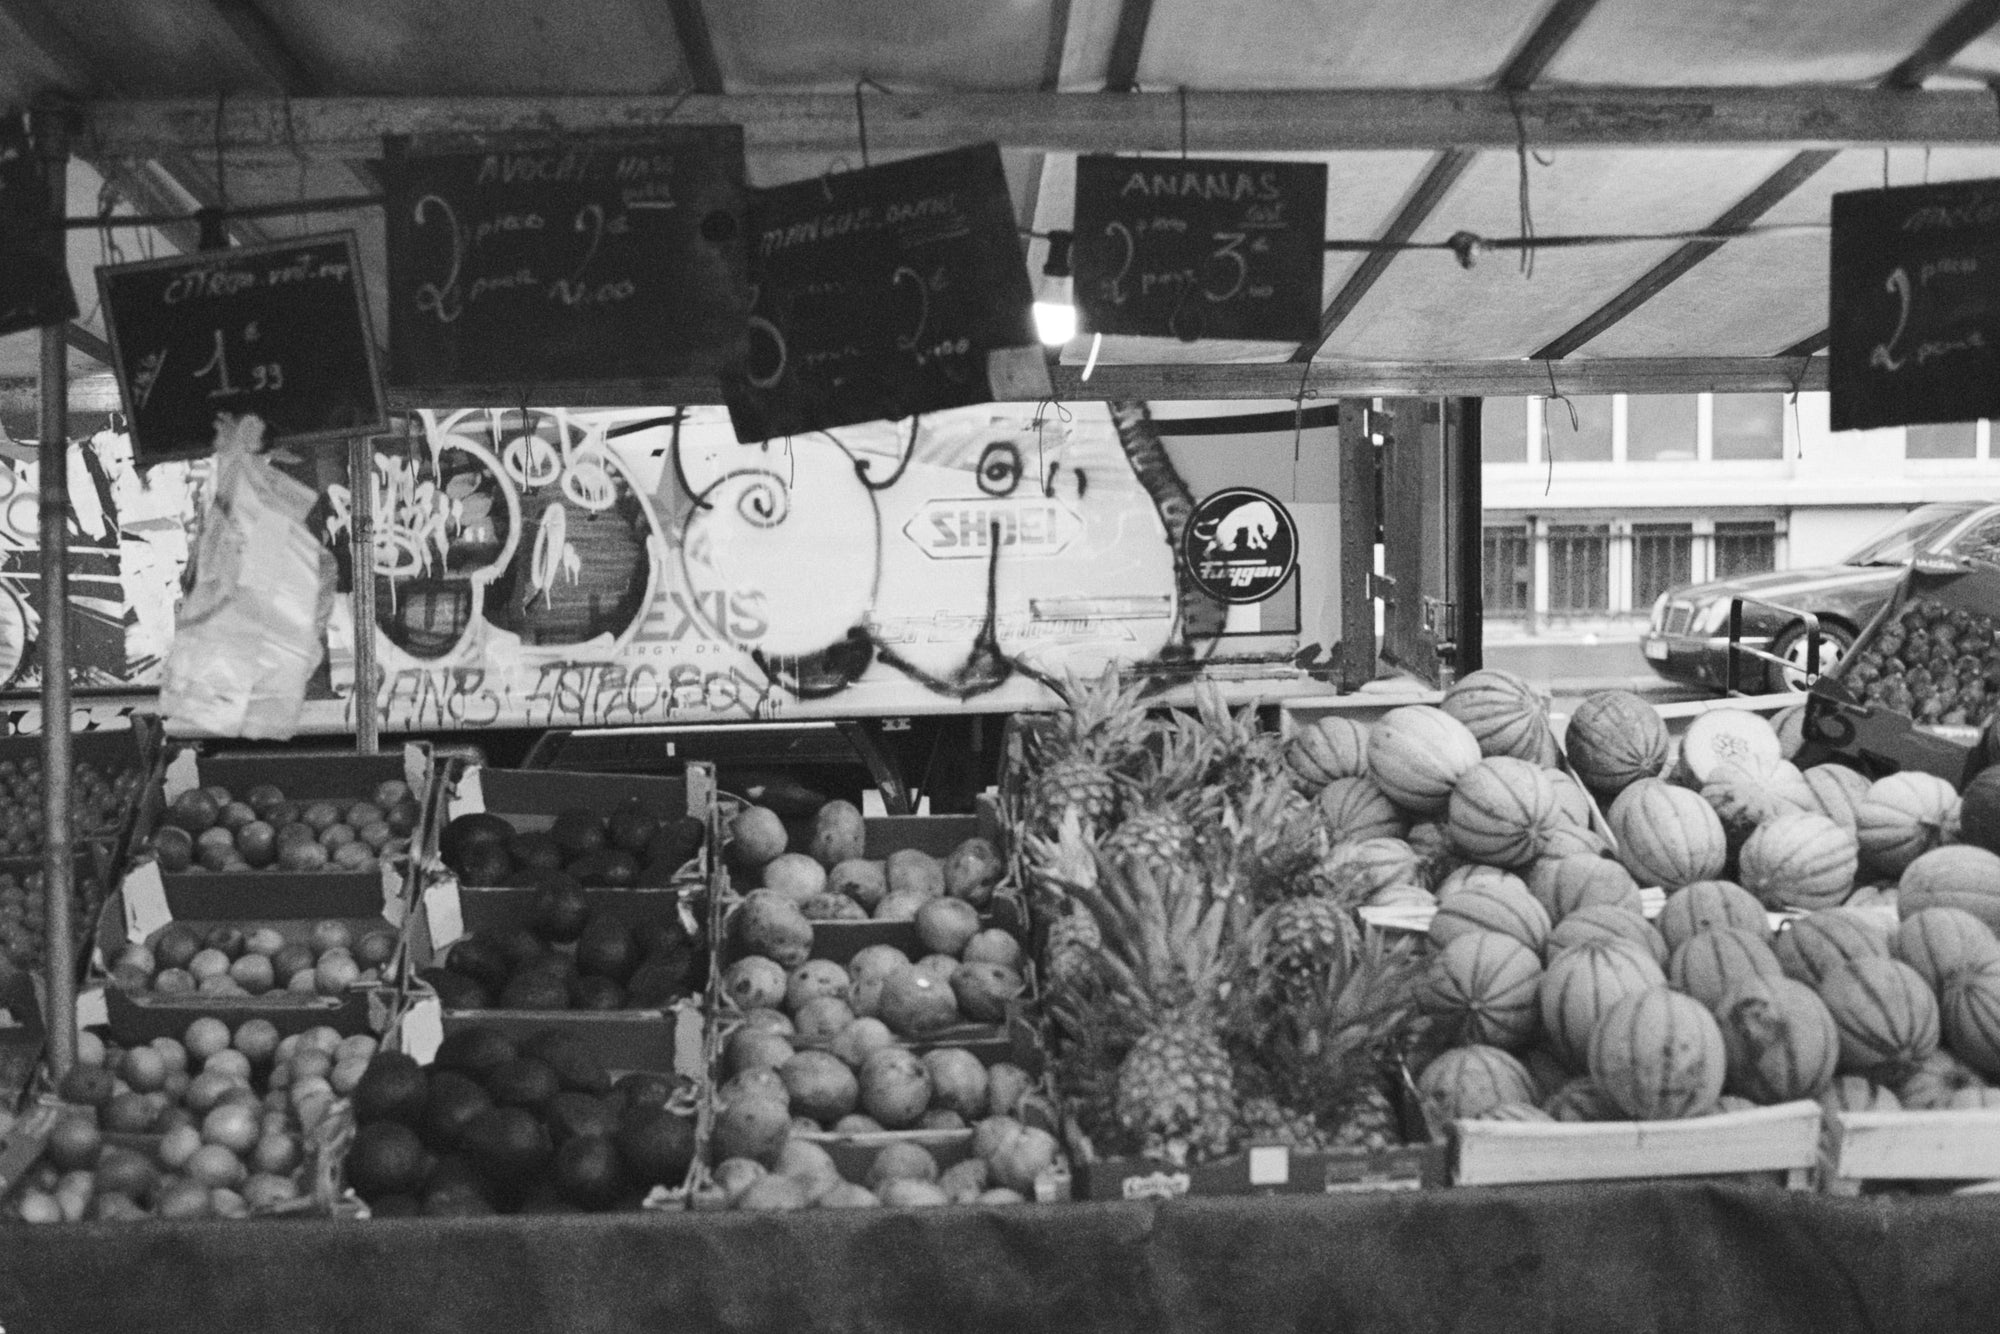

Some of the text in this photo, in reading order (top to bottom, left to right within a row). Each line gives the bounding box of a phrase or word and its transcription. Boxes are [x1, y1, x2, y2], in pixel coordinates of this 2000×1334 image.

[1119, 172, 1280, 201] ANANAS
[1203, 232, 1247, 303] 3
[930, 506, 1057, 548] SHOEI
[695, 643, 764, 655] DRNK
